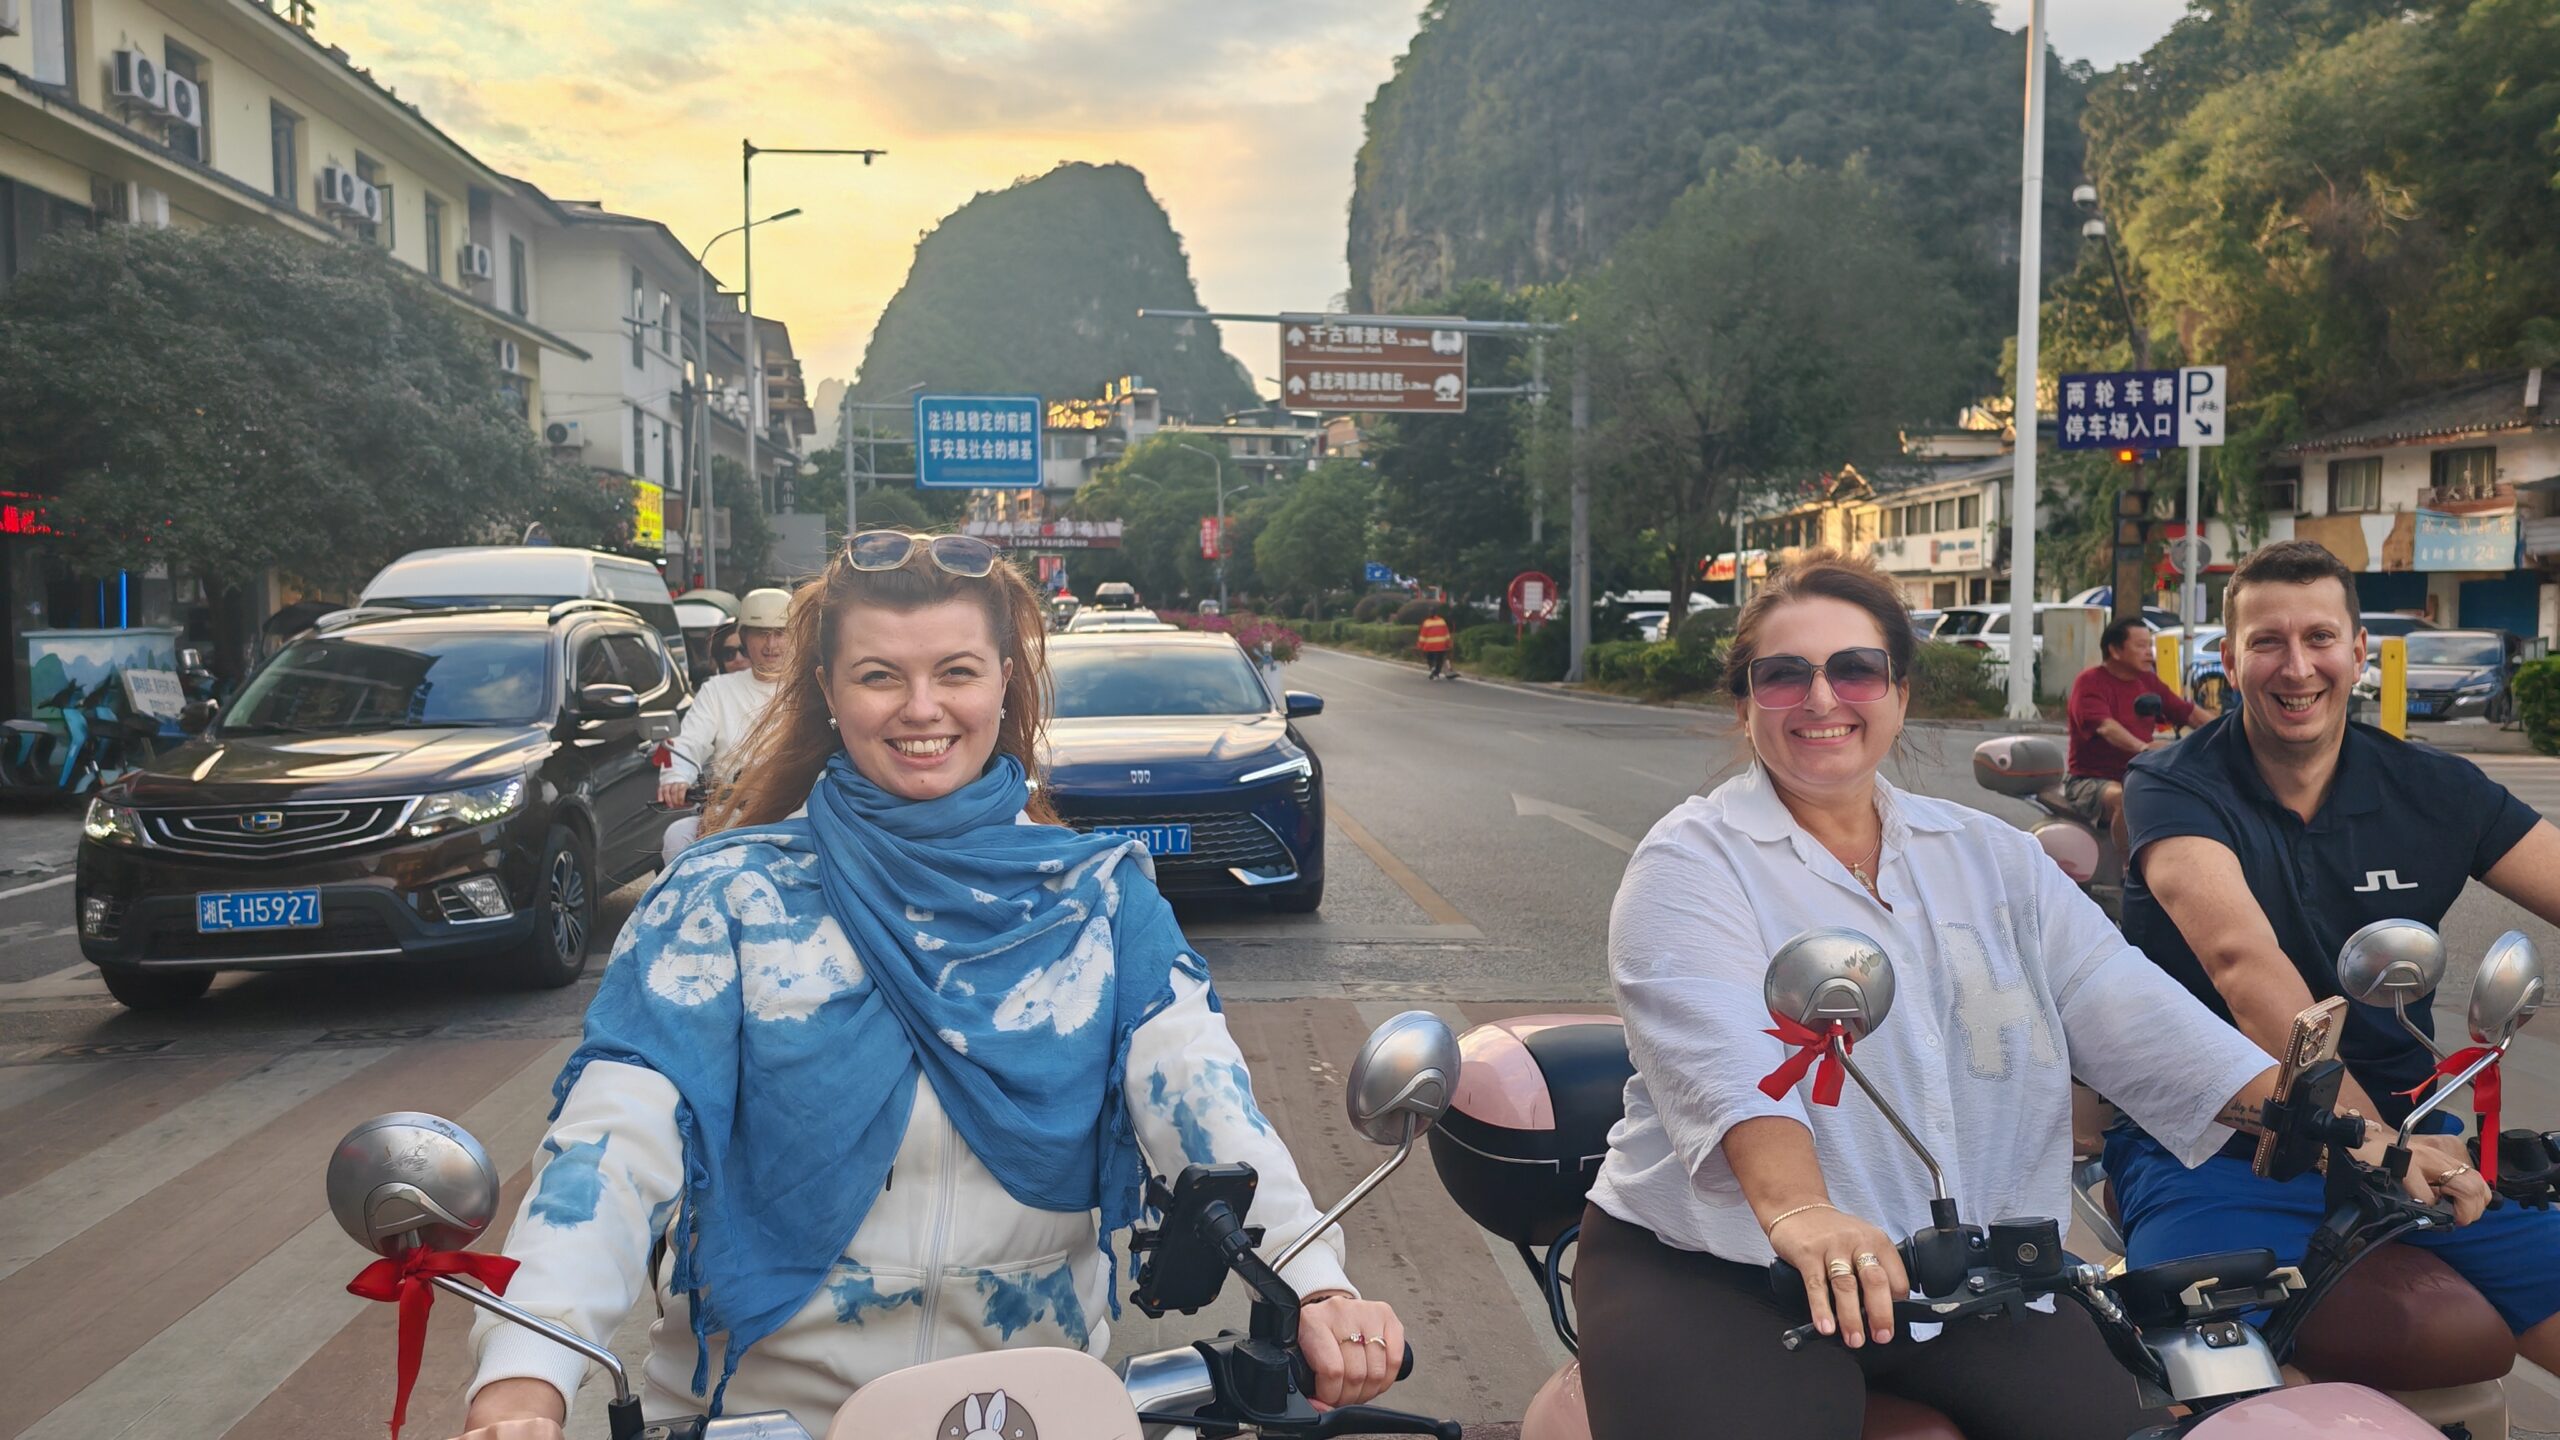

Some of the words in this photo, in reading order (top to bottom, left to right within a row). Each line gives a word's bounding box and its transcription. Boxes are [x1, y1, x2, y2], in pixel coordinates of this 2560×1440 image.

[1309, 325, 1400, 345] 千古情景区
[2066, 377, 2174, 410] 两轮车辆
[2186, 371, 2214, 415] P
[928, 410, 1032, 433] 法治是稳定的前提
[2065, 411, 2172, 442] 停车场入口
[929, 438, 1033, 460] 平安是社会的根基
